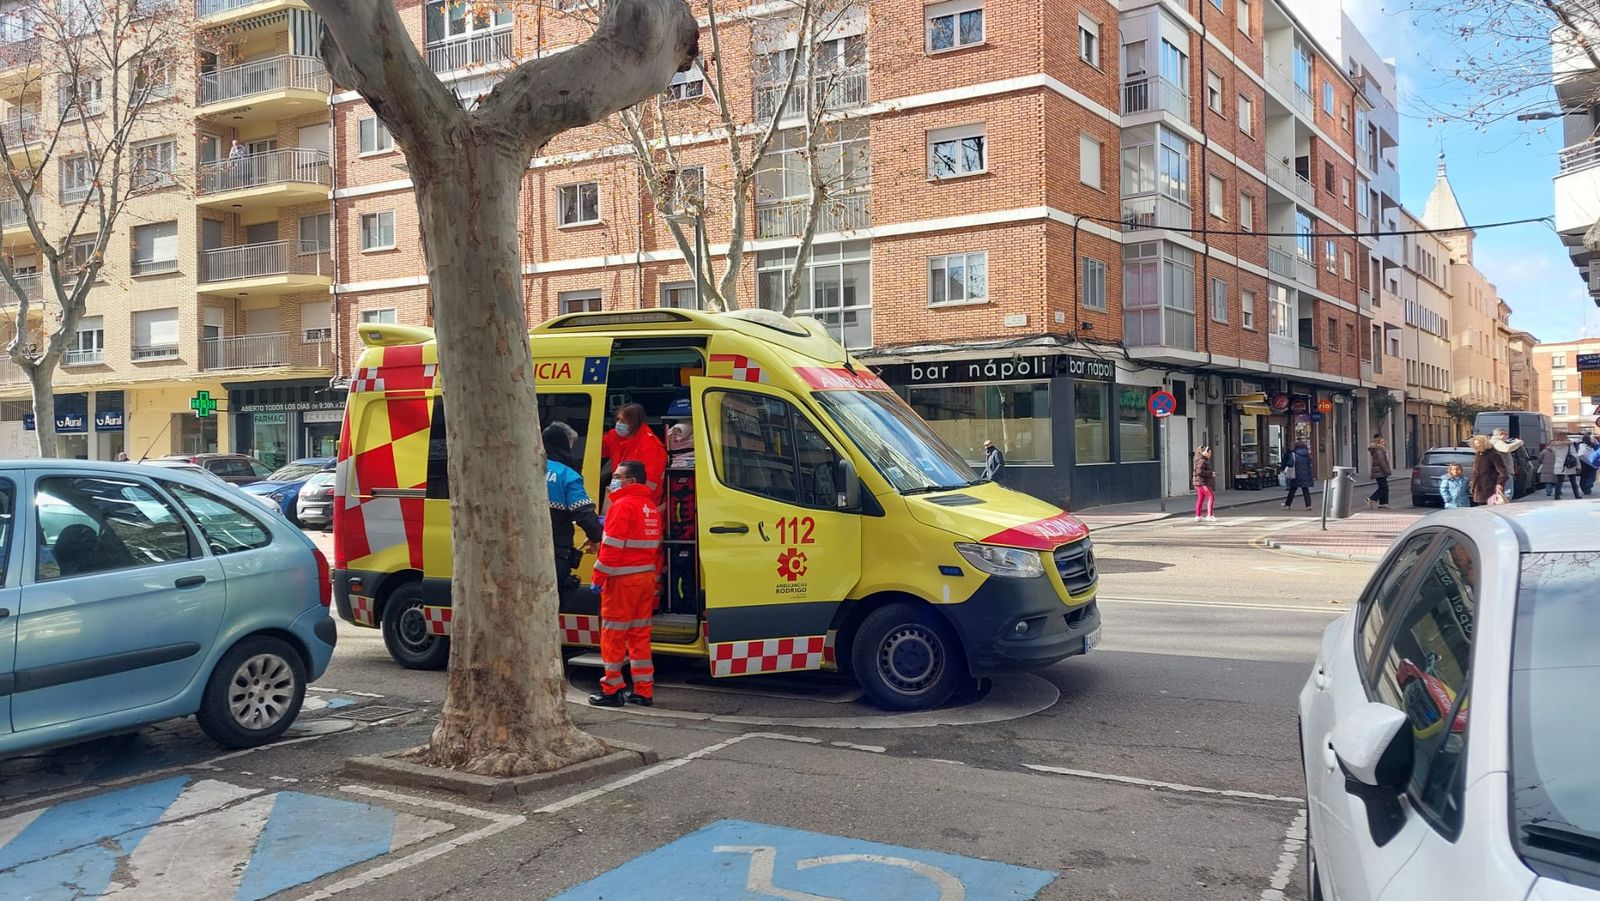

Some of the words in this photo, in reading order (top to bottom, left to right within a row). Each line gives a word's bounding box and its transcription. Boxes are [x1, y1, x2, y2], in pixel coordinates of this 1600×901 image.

[911, 364, 949, 380] bar
[969, 357, 1046, 379] nápoli
[1069, 357, 1085, 374] bar
[1087, 358, 1114, 377] nápoli
[241, 404, 264, 412] ABIERTO
[297, 402, 310, 410] DÍAS
[64, 417, 82, 427] Aural
[104, 415, 122, 426] Aural
[776, 516, 815, 544] 112
